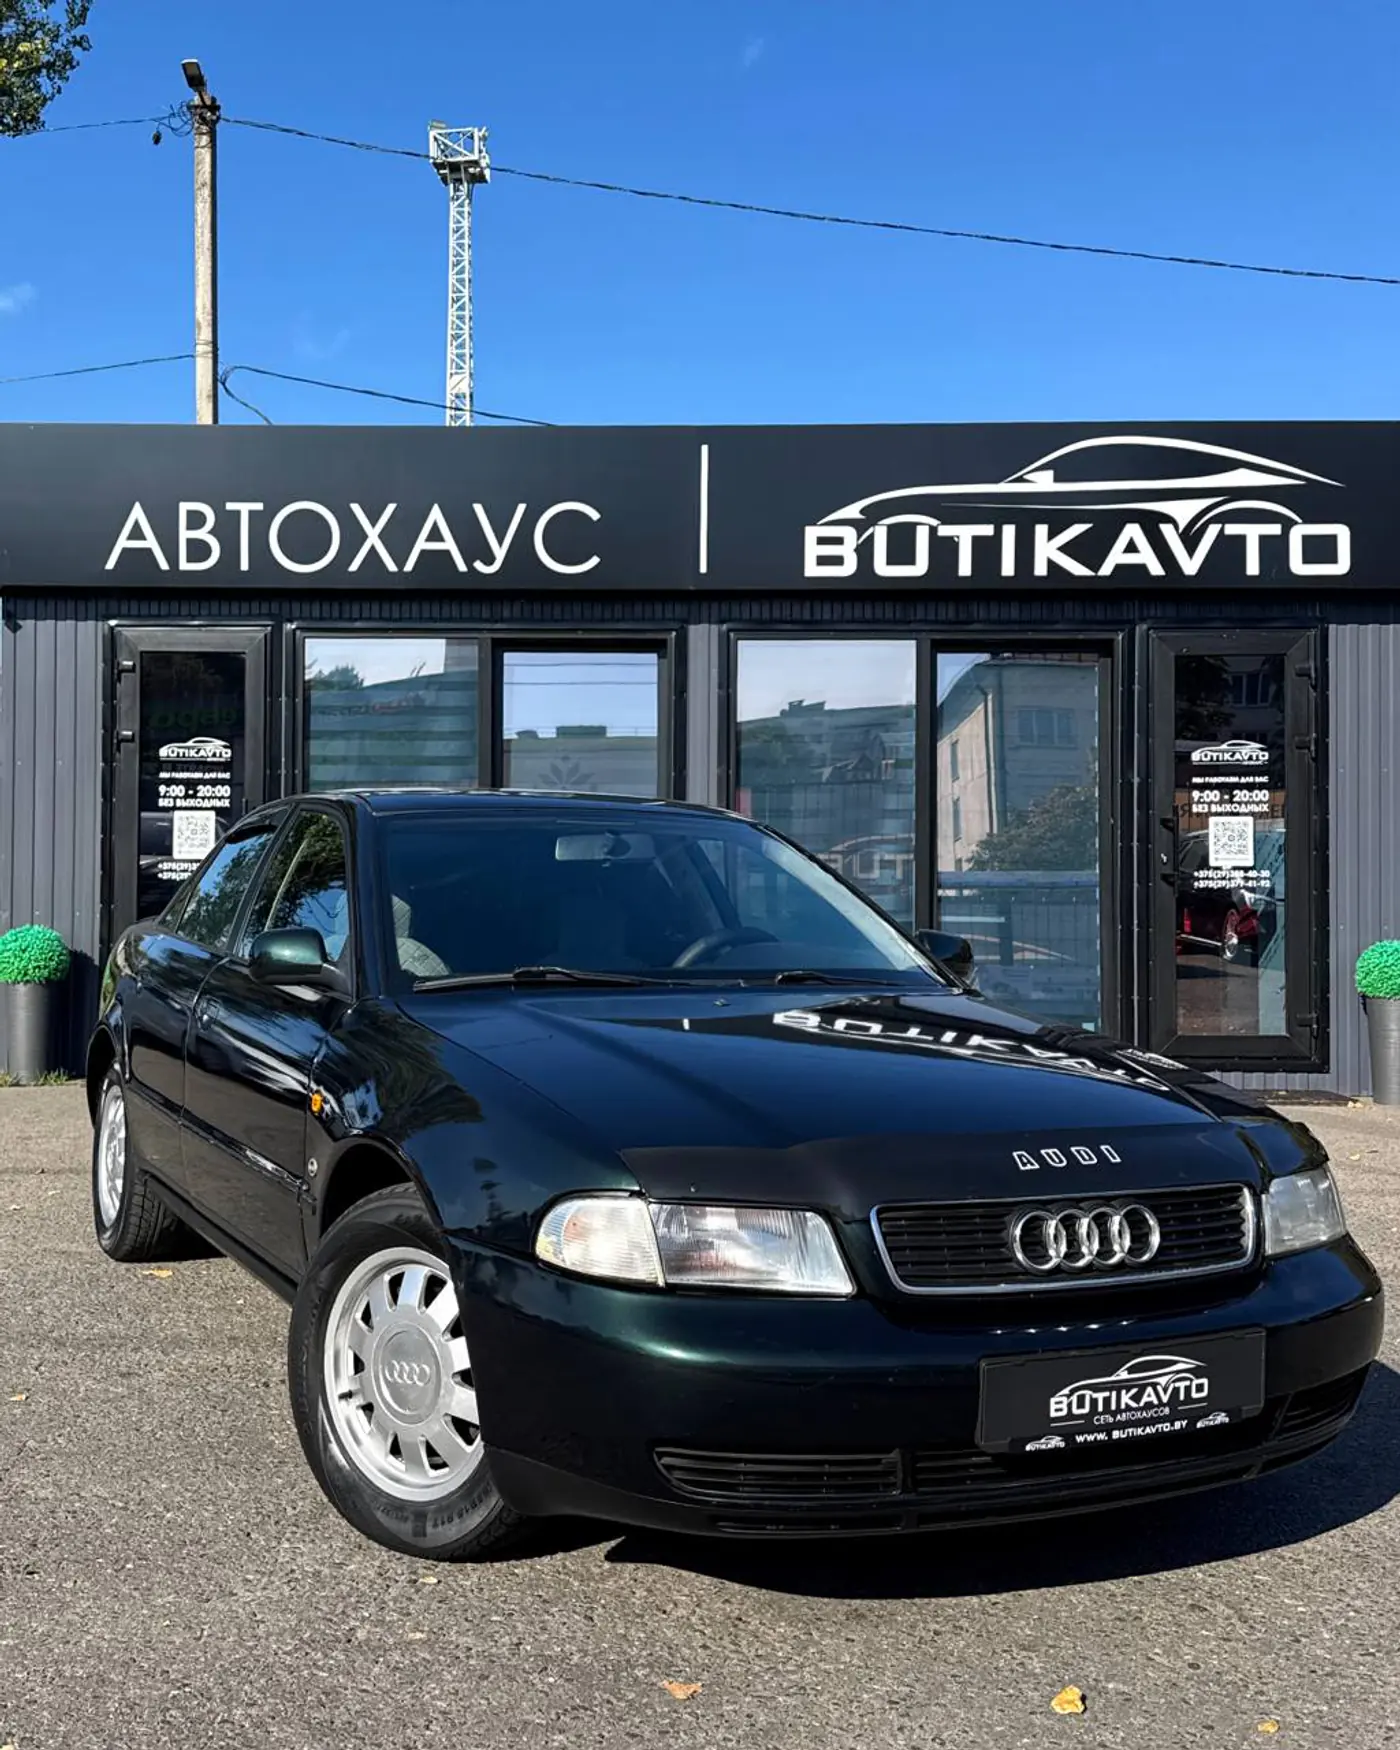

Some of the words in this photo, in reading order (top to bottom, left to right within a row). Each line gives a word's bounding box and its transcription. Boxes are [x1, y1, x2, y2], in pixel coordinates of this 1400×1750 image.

[105, 500, 602, 575] АВТОХАУС
[804, 523, 1351, 578] BUTIKAVTO
[159, 748, 232, 758] BUTIKAVTO
[1191, 751, 1269, 762] BUTIKAVTO
[158, 784, 186, 797] 9:00
[196, 784, 231, 797] 20:00
[1192, 789, 1221, 803] 9:00
[1233, 789, 1270, 803] 20:00
[158, 798, 174, 808] БЕЗ
[176, 798, 231, 808] ВЫХОДНЫХ
[1191, 803, 1209, 813] БЕЗ
[1211, 803, 1270, 813] ВЫХОДНЫХ
[1012, 1145, 1122, 1170] AUDI
[1049, 1378, 1209, 1418] BUTIKAVTO
[1093, 1414, 1113, 1425] СЕТЬ
[1115, 1407, 1171, 1422] АВТОХАУСОВ
[1111, 1419, 1188, 1440] BUTIKAVTO.BY
